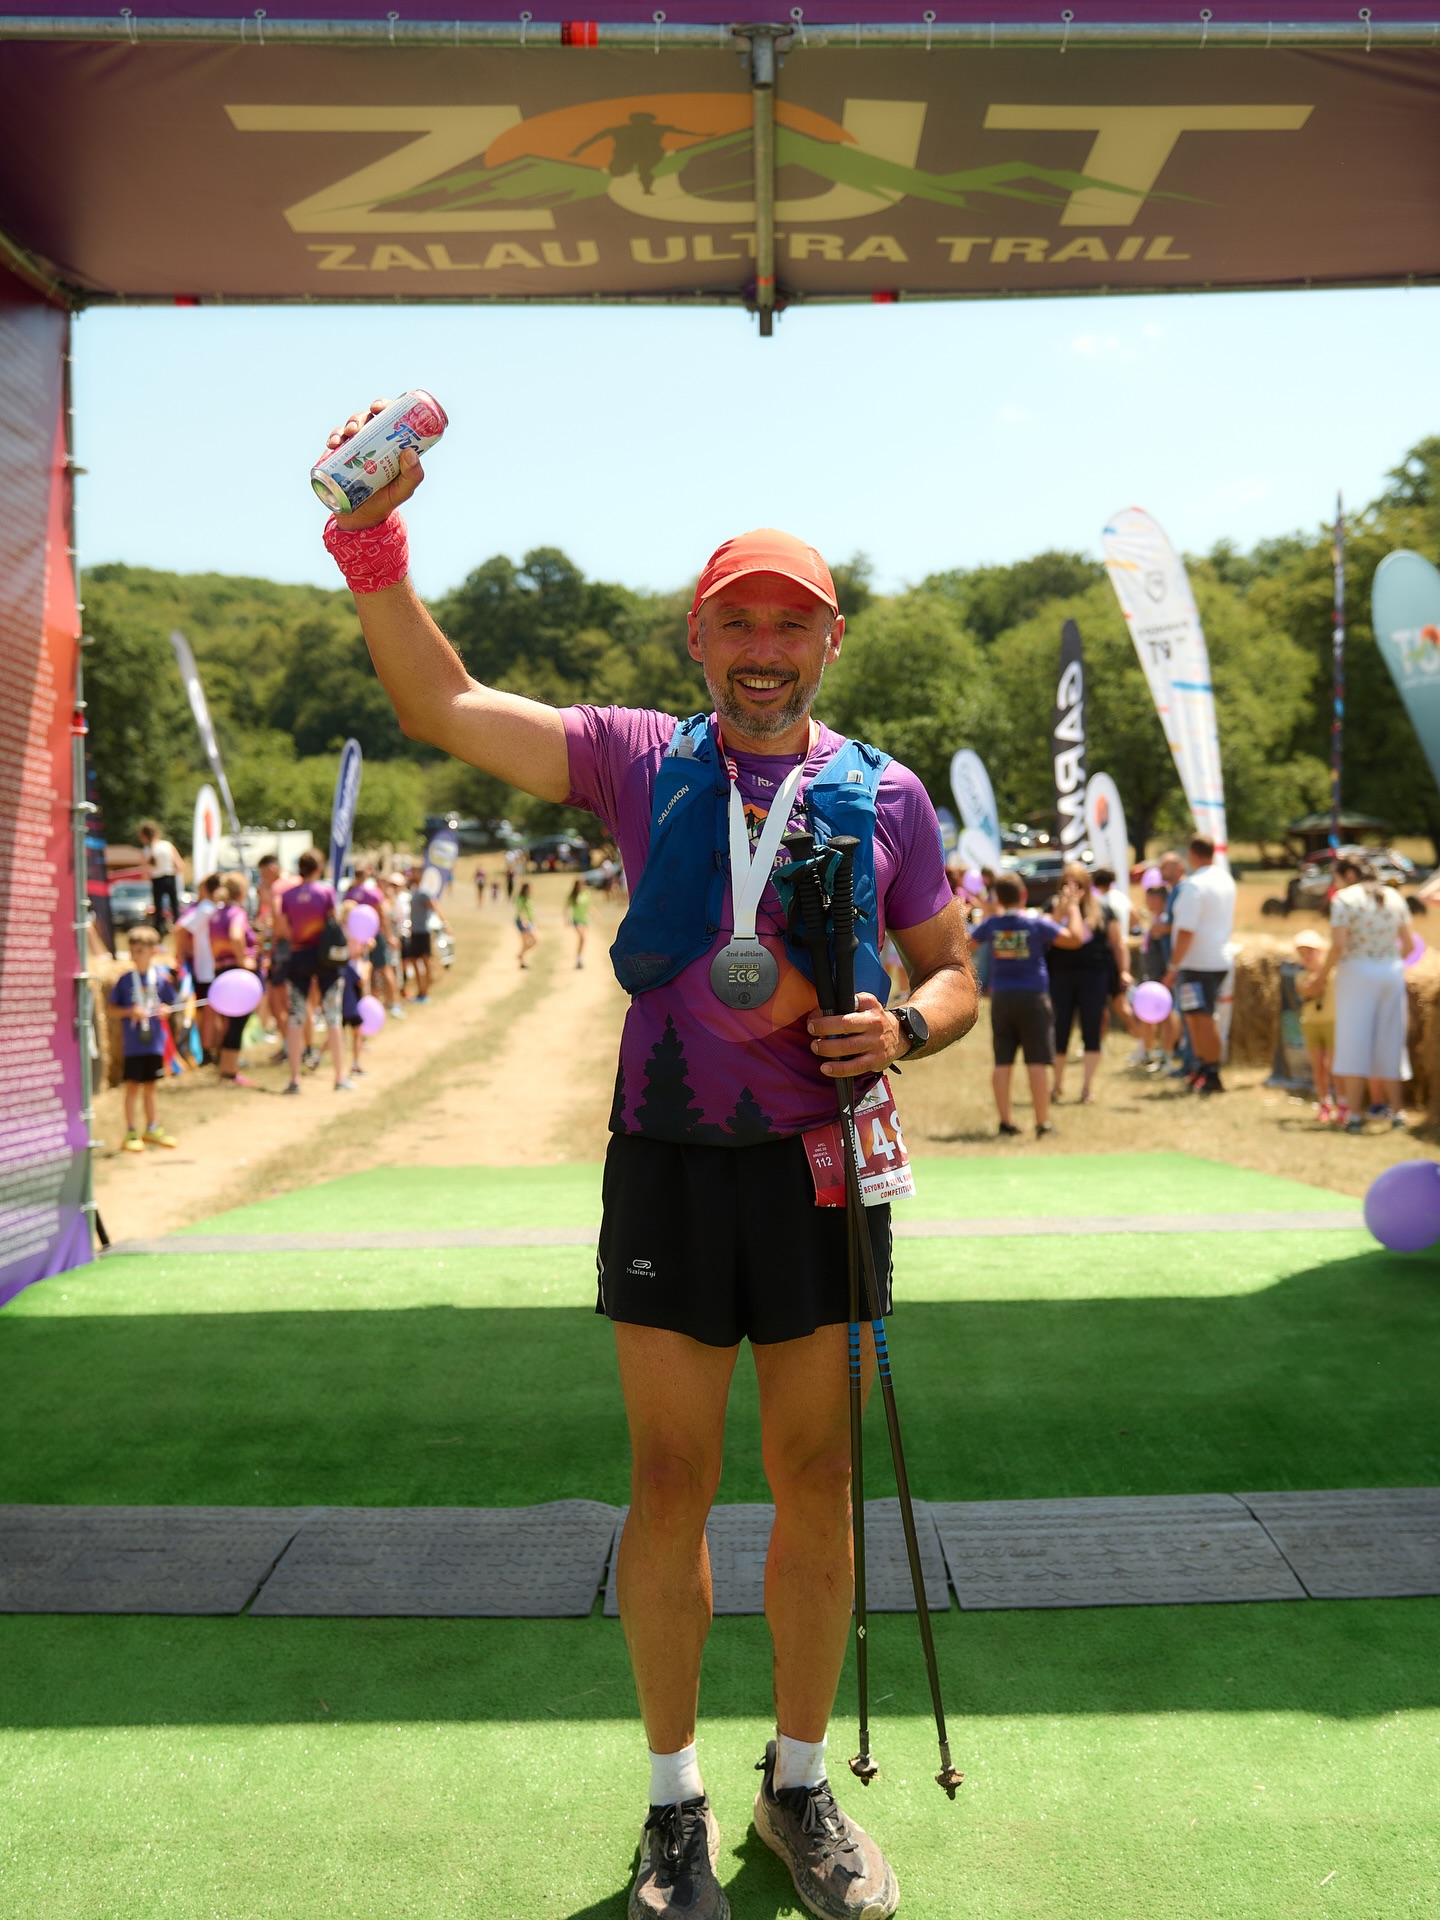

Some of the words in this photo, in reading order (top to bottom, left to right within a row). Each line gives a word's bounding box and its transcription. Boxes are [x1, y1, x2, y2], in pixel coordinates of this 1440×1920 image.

[307, 240, 600, 271] ZALAU
[937, 235, 1191, 263] TRAIL
[657, 784, 690, 826] SALOMON
[725, 950, 739, 958] 2nd
[740, 950, 764, 958] edition
[728, 969, 760, 983] EGO
[816, 1156, 833, 1168] 112
[863, 1181, 885, 1194] BEYOND
[885, 1180, 890, 1188] A
